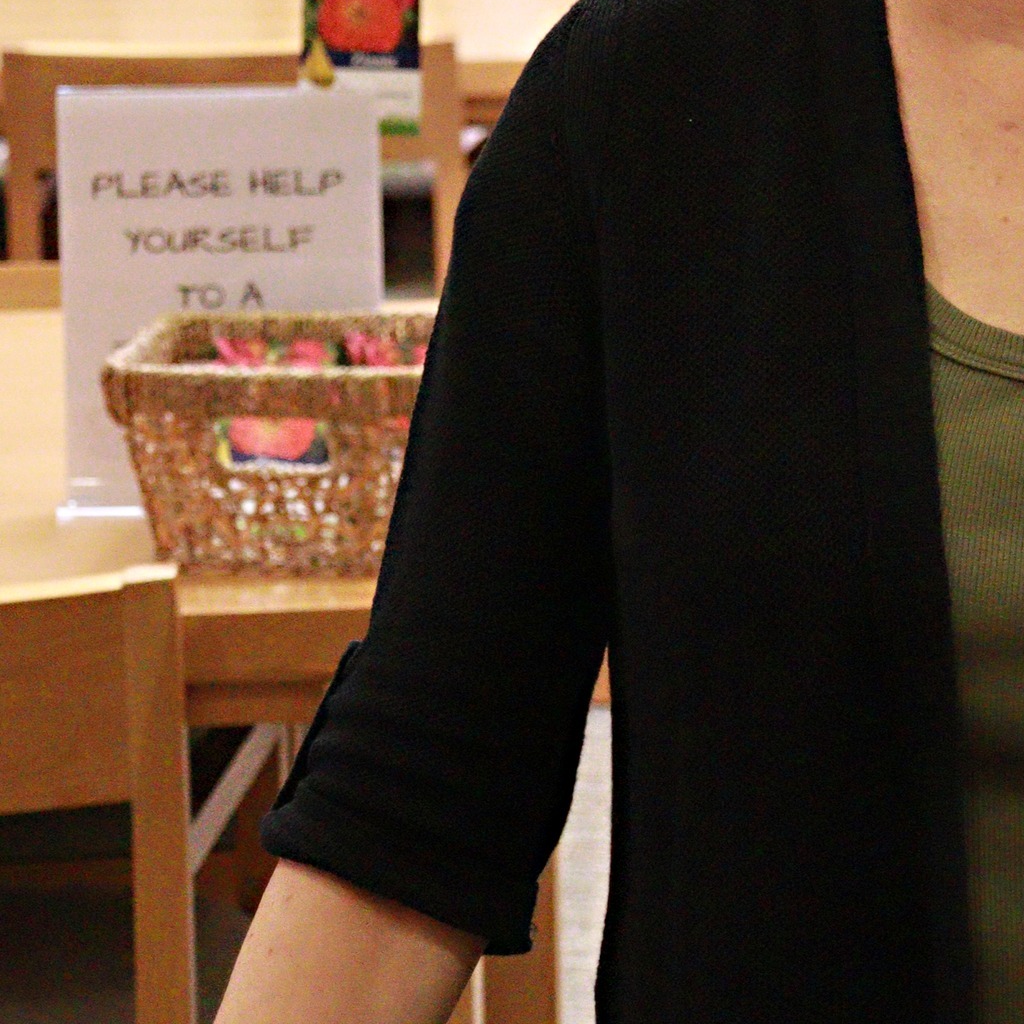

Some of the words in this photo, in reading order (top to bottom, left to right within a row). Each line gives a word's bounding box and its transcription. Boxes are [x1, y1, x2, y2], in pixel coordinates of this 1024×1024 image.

[91, 170, 231, 199] PLEASE
[248, 168, 345, 197] HELP
[123, 225, 314, 254] YOURSELF
[178, 282, 227, 309] TO
[239, 280, 264, 309] A
